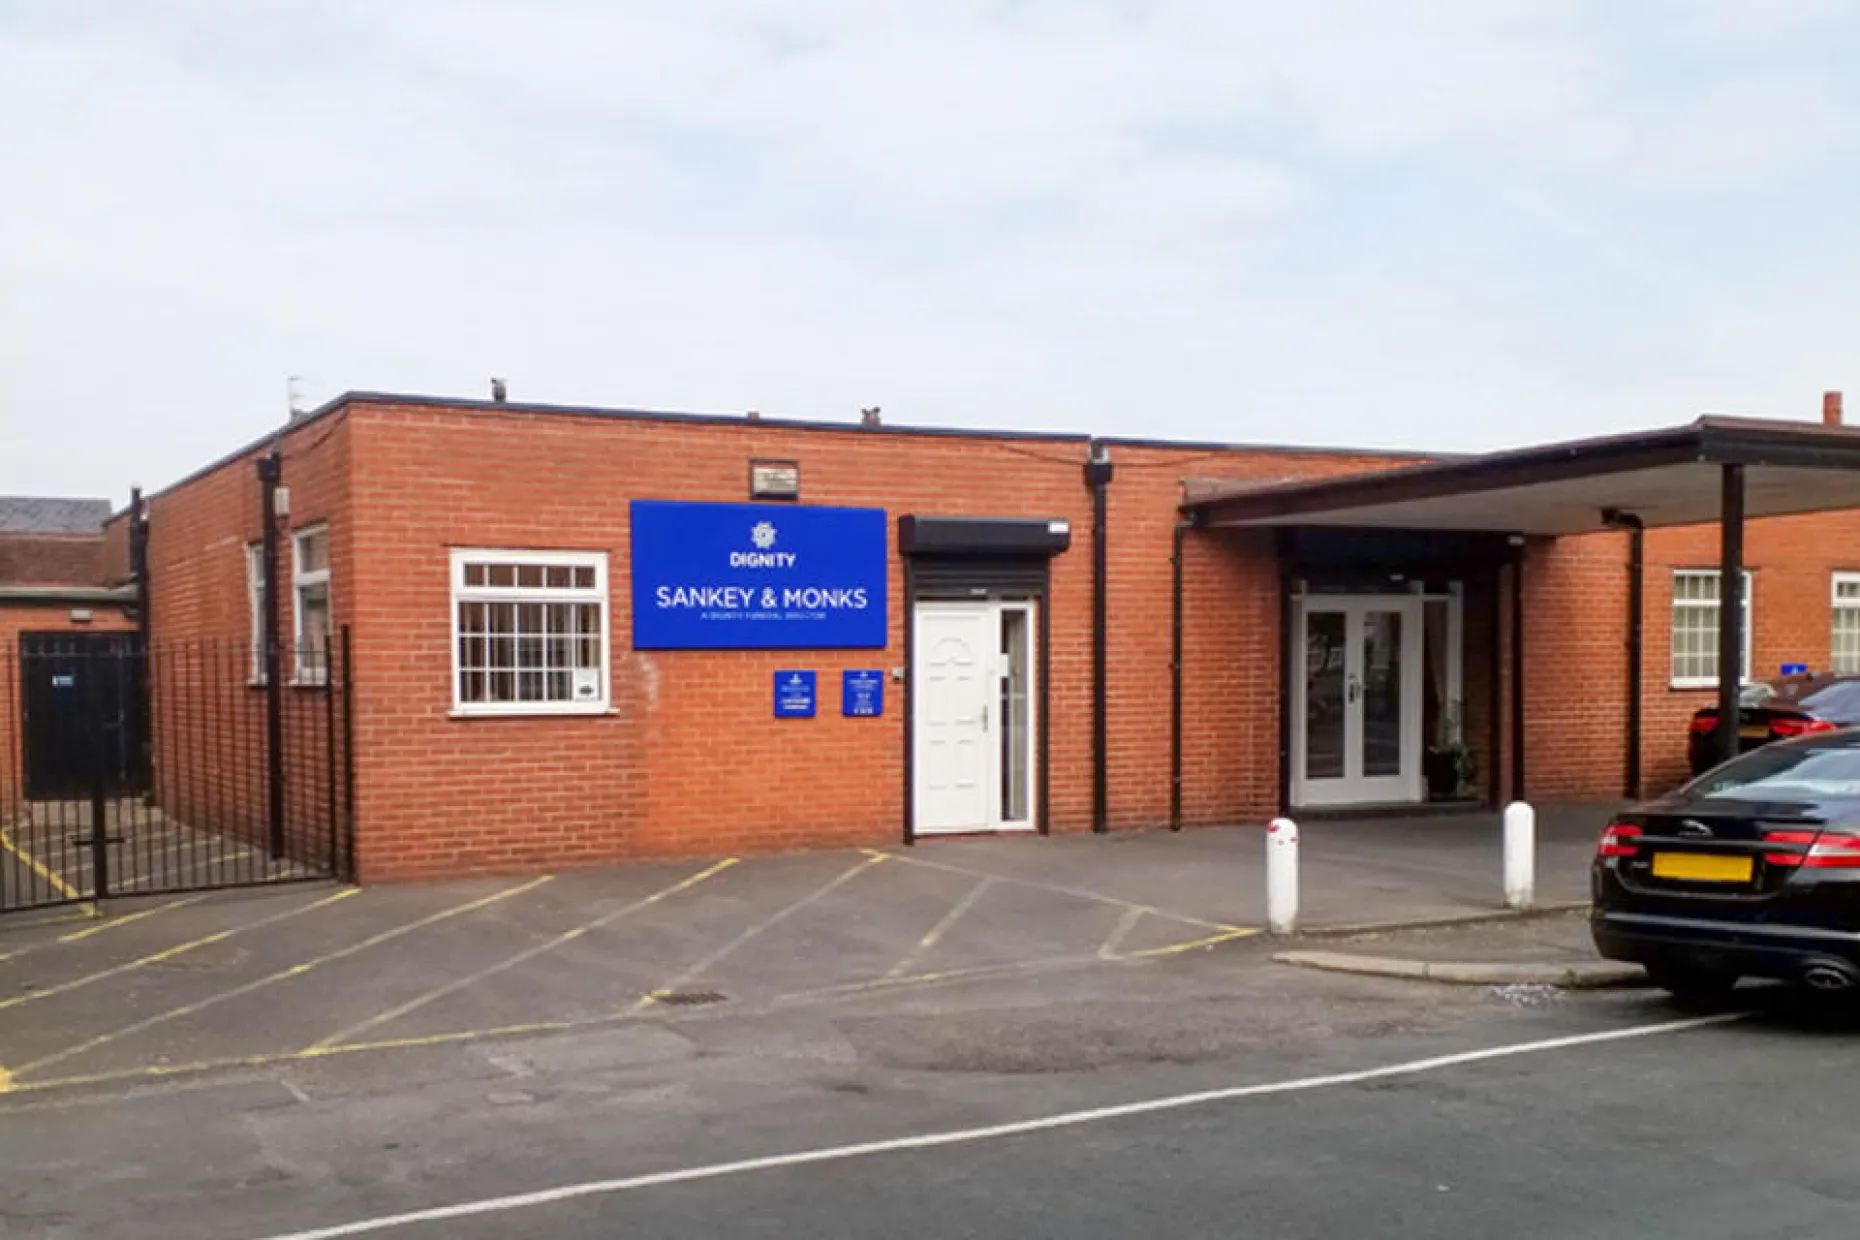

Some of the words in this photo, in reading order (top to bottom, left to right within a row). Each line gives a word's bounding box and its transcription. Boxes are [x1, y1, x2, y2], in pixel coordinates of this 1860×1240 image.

[730, 552, 796, 567] DIGNITY
[656, 587, 754, 608] SANKEY
[760, 588, 777, 608] &
[783, 588, 868, 609] MONKS
